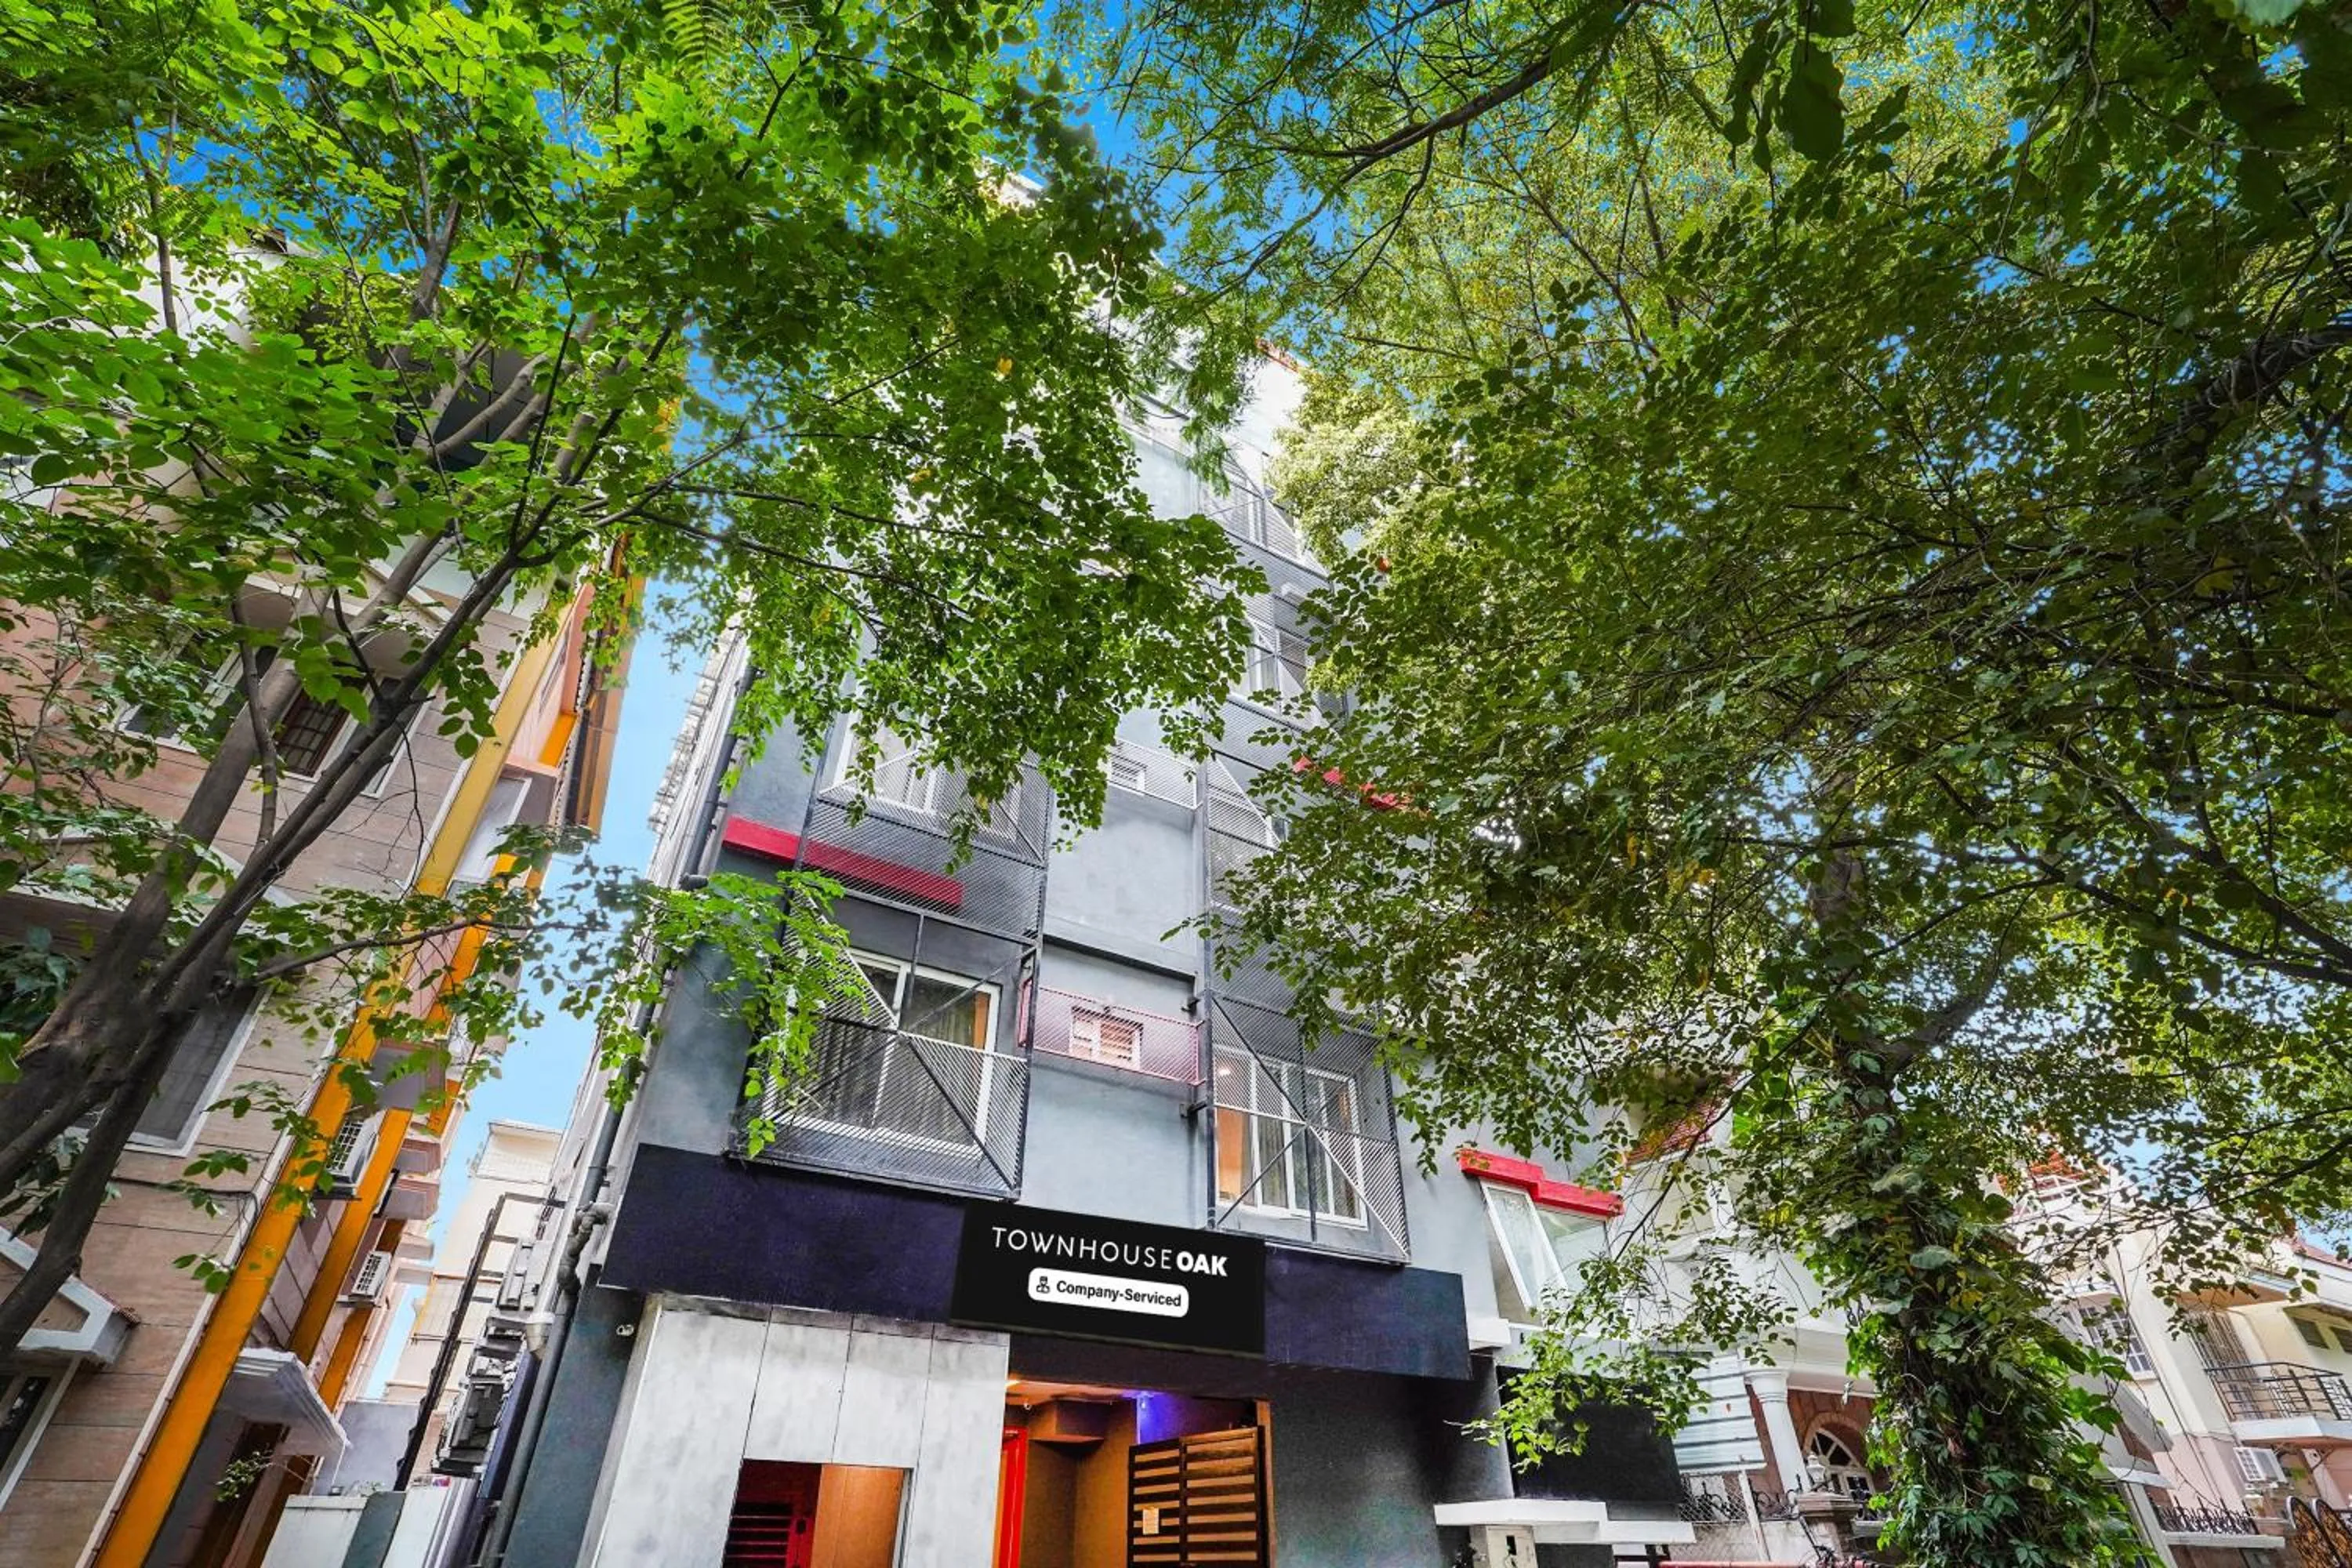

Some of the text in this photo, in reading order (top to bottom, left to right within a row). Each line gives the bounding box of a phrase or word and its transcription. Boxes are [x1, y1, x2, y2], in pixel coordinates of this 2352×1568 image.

[992, 1226, 1228, 1277] TOWNHOUSE OAK
[1056, 1280, 1181, 1307] Company-Serviced
